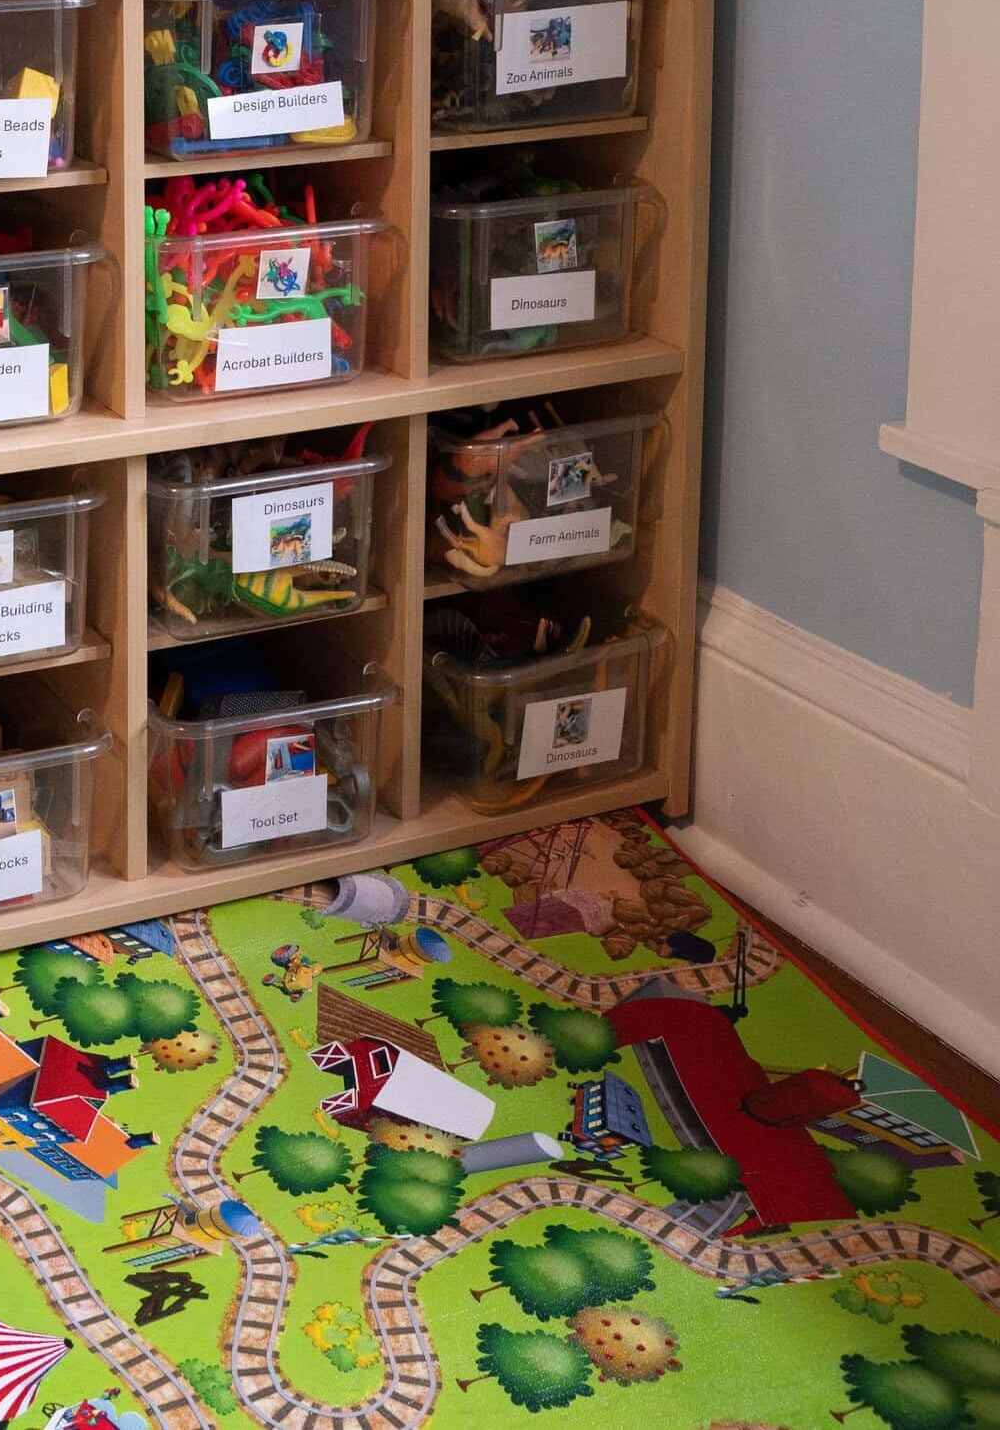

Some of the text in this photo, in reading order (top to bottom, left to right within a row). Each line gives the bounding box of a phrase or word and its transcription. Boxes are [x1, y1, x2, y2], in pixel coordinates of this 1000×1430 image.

[506, 66, 574, 85] Zoo Animals
[233, 93, 328, 114] Design Builders
[4, 120, 45, 133] Beads
[511, 297, 568, 311] Dinosaurs
[222, 350, 324, 372] Acrobat Builders
[263, 496, 325, 516] Dinosaurs
[529, 528, 600, 546] Farm Animals
[0, 601, 53, 618] Building
[546, 747, 598, 765] Dinosaurs
[249, 812, 298, 830] Tool Set
